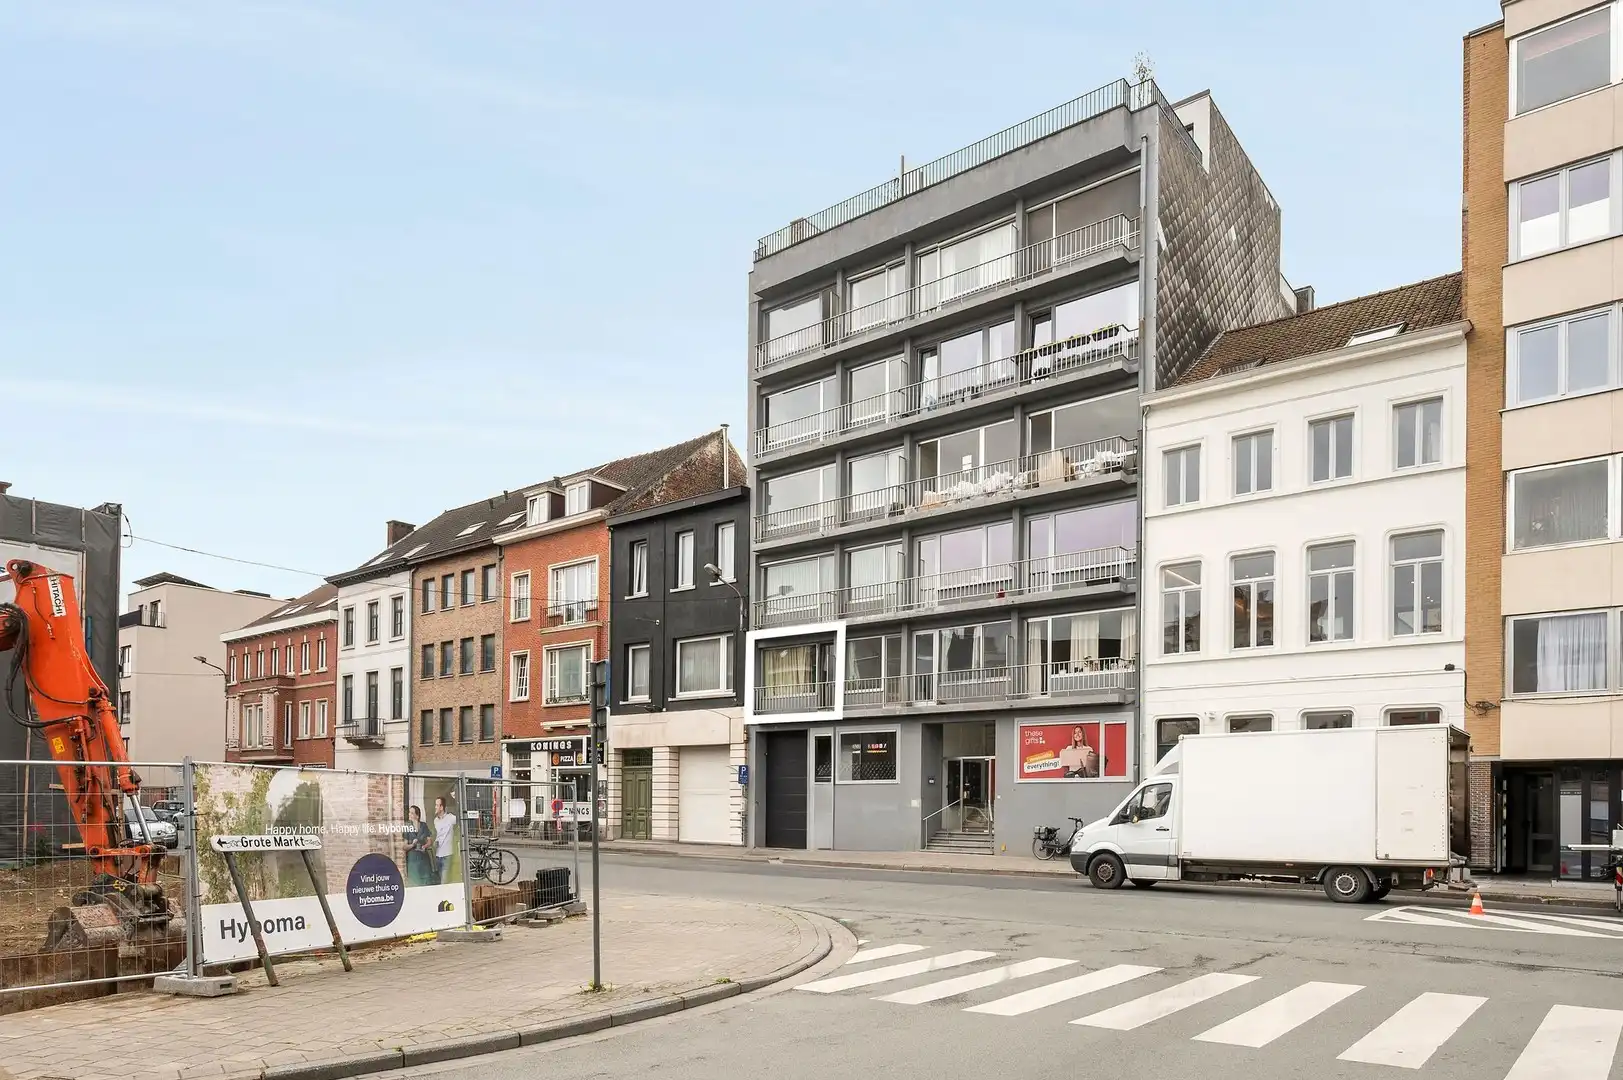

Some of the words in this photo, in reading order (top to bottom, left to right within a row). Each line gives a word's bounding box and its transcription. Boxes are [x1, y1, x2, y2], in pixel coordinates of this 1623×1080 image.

[51, 578, 63, 615] HITACHI
[530, 741, 572, 751] KONINGS
[741, 766, 747, 775] P
[265, 823, 297, 836] Happy
[331, 823, 360, 836] Happy
[378, 823, 417, 836] Hyboma.
[240, 836, 271, 848] Grote
[274, 836, 305, 847] Markt
[360, 874, 375, 883] Vind
[375, 874, 390, 883] jouw
[352, 885, 375, 894] nieuwe
[375, 884, 390, 892] thuis
[390, 884, 399, 892] op
[359, 894, 395, 906] hyboma.be
